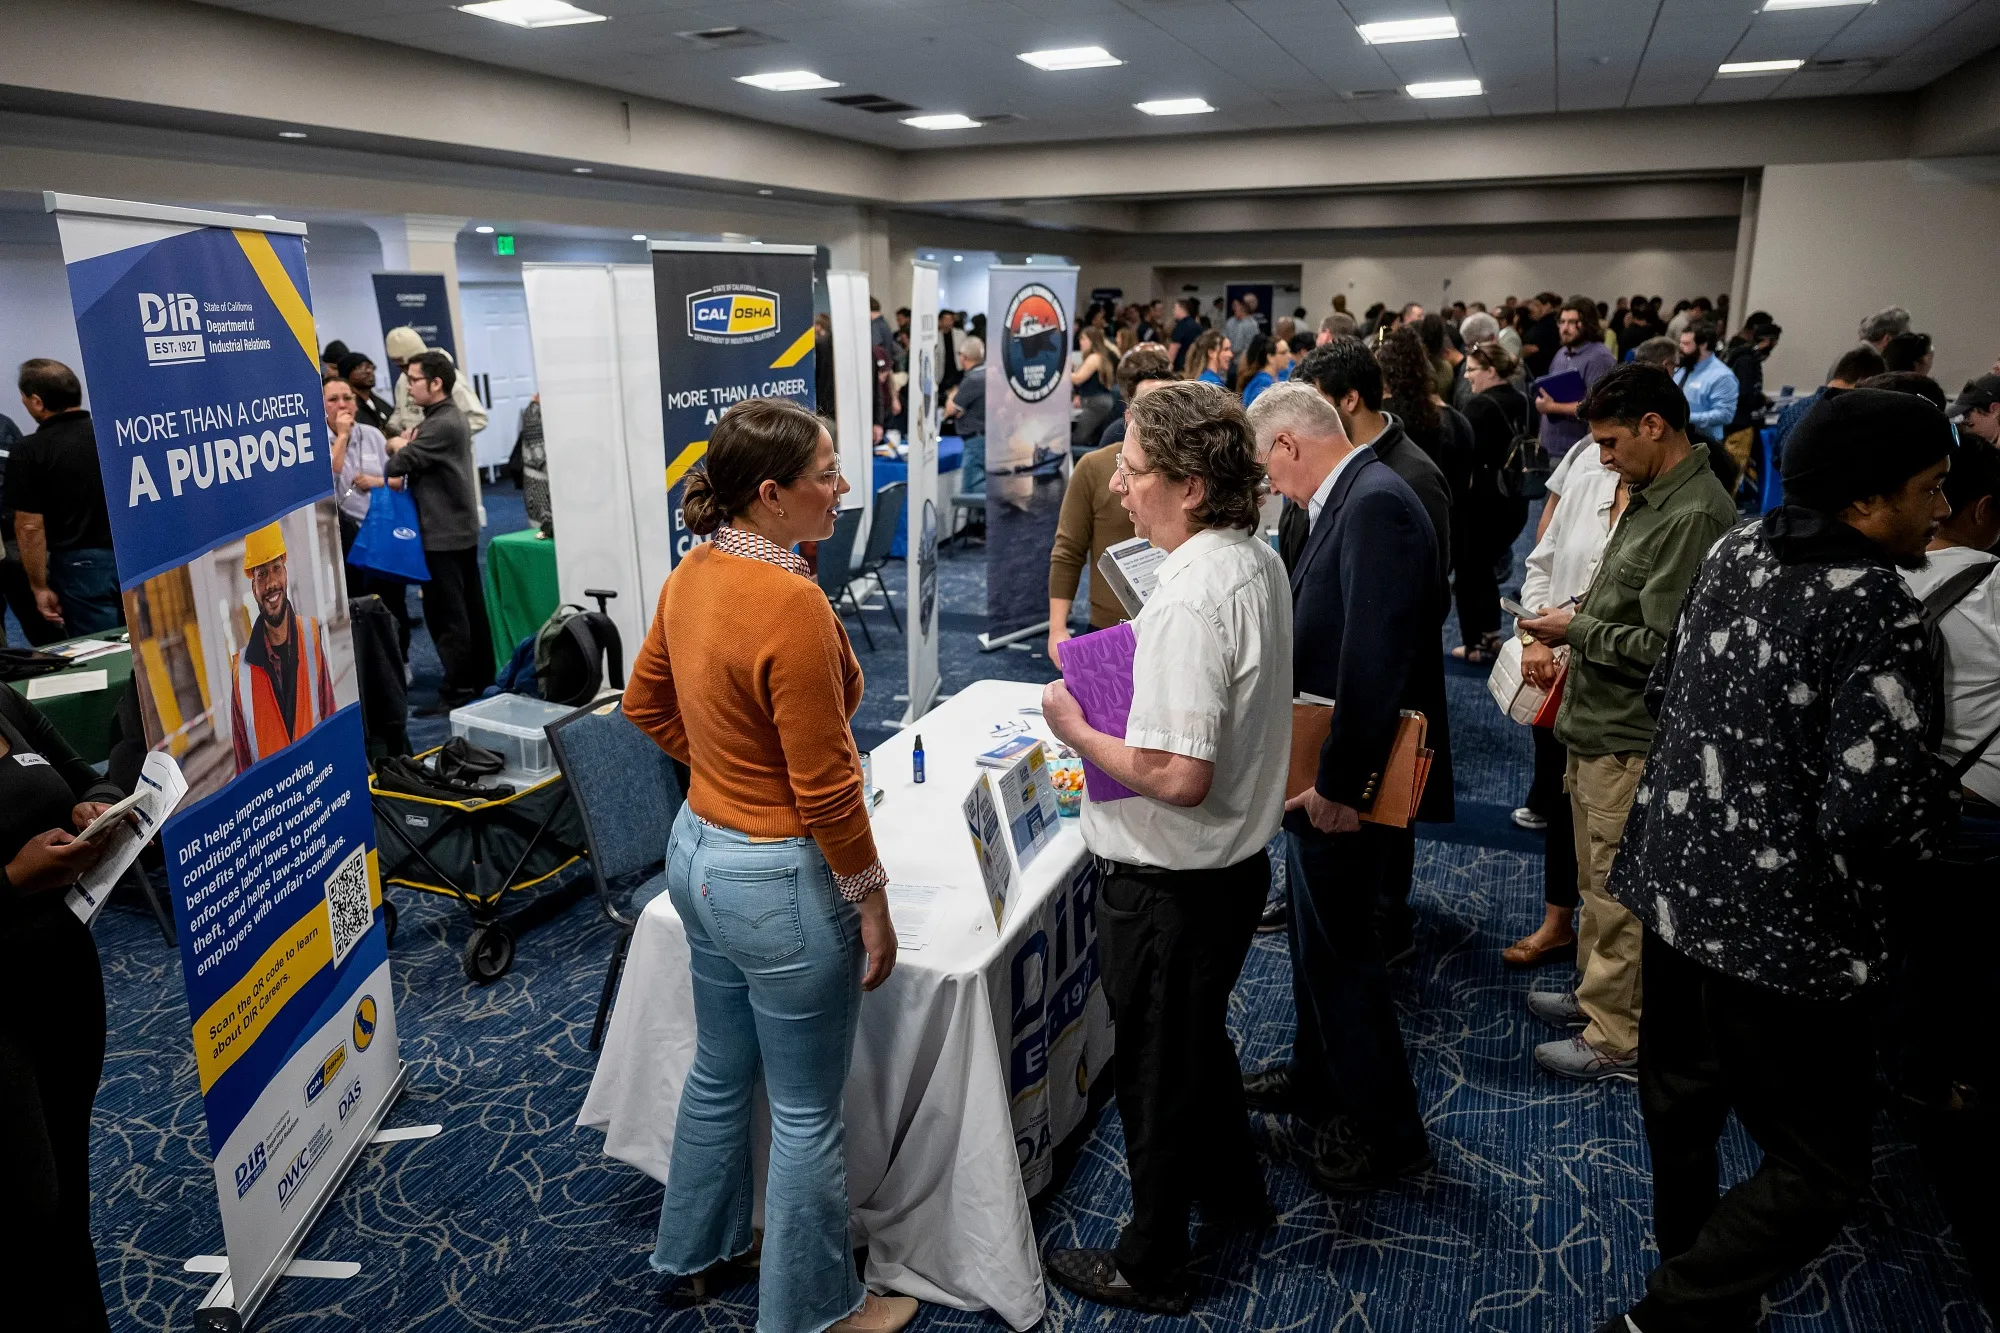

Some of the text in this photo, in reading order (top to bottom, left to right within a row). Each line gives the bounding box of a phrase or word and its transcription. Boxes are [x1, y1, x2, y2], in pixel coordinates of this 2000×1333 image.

[204, 302, 252, 312] State of California
[206, 318, 255, 335] Department of
[698, 307, 771, 321] CAL OSHA
[154, 341, 197, 354] EST. 1927
[209, 338, 271, 353] Industrial Relations
[115, 393, 309, 447] MORE THAN A CAREER,
[668, 378, 809, 410] MORE THAN A CAREER,
[704, 408, 718, 426] A
[128, 423, 314, 508] A PURPOSE
[178, 759, 314, 866] DIR helps improve working
[183, 762, 334, 888] conditions in California, ensures
[186, 796, 323, 911] benefits for injured workers,
[190, 789, 351, 932] enforces labor laws to prevent wage
[193, 833, 326, 955] theft, and helps law-abiding
[197, 834, 346, 977] employers with unfair conditions.
[209, 928, 318, 1040] Scan the QR code to learn
[213, 974, 291, 1060] about DIR Careers.
[308, 1076, 324, 1096] CAL
[326, 1052, 344, 1076] OSHA
[338, 1080, 362, 1122] DAS
[278, 1147, 310, 1202] DWC
